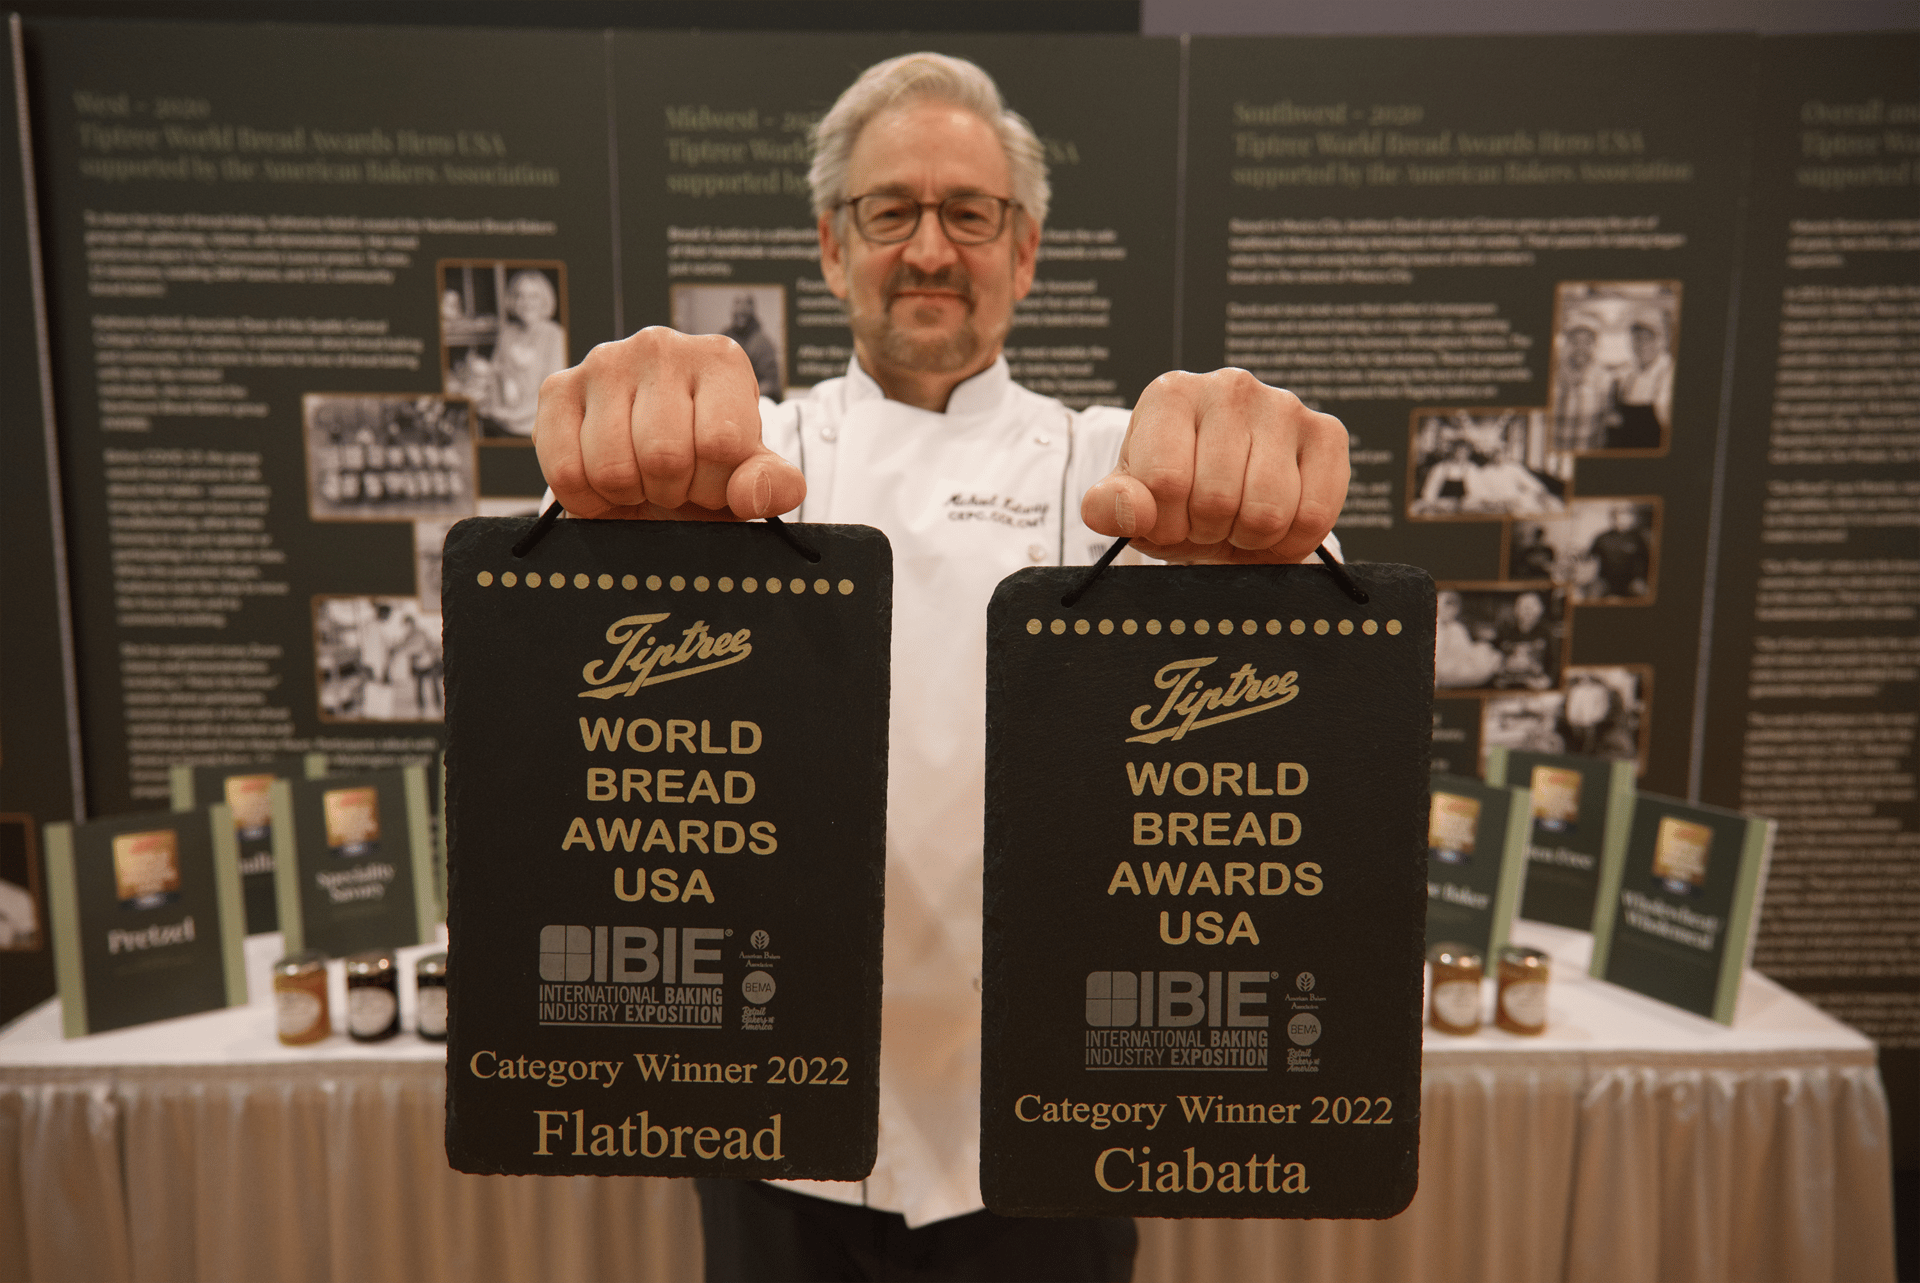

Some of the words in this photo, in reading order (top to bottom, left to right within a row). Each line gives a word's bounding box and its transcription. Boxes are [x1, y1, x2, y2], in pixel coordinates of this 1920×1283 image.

[665, 104, 758, 131] Midwest
[664, 136, 747, 167] Tiptree
[578, 613, 752, 699] Tiptree
[1125, 657, 1299, 744] Tiptree
[579, 717, 762, 754] WORLD
[587, 768, 755, 804] BREAD
[1126, 762, 1309, 796] WORLD
[562, 817, 777, 855] AWARDS
[1133, 812, 1302, 847] BREAD
[614, 868, 715, 903] USA
[1108, 861, 1323, 897] AWARDS
[107, 915, 195, 955] Pretzel
[1160, 911, 1260, 946] USA
[539, 984, 660, 1005] INTERNATIONAL
[664, 987, 723, 1006] BAKING
[745, 982, 773, 993] BEMA
[539, 1002, 620, 1021] INDUSTRY
[625, 1005, 723, 1024] EXPOSITION
[1290, 1024, 1318, 1035] BEMA
[1085, 1030, 1206, 1048] INTERNATIONAL
[1210, 1030, 1269, 1048] BAKING
[470, 1050, 623, 1088] Category
[634, 1053, 758, 1084] Winner
[767, 1056, 850, 1086] 2022
[1085, 1048, 1165, 1066] INDUSTRY
[1170, 1048, 1268, 1066] EXPOSITION
[1015, 1094, 1167, 1131] Category
[1177, 1094, 1302, 1124] Winner
[1311, 1096, 1393, 1125] 2022
[533, 1110, 785, 1161] Flatbread
[1095, 1147, 1311, 1194] Ciabatta
